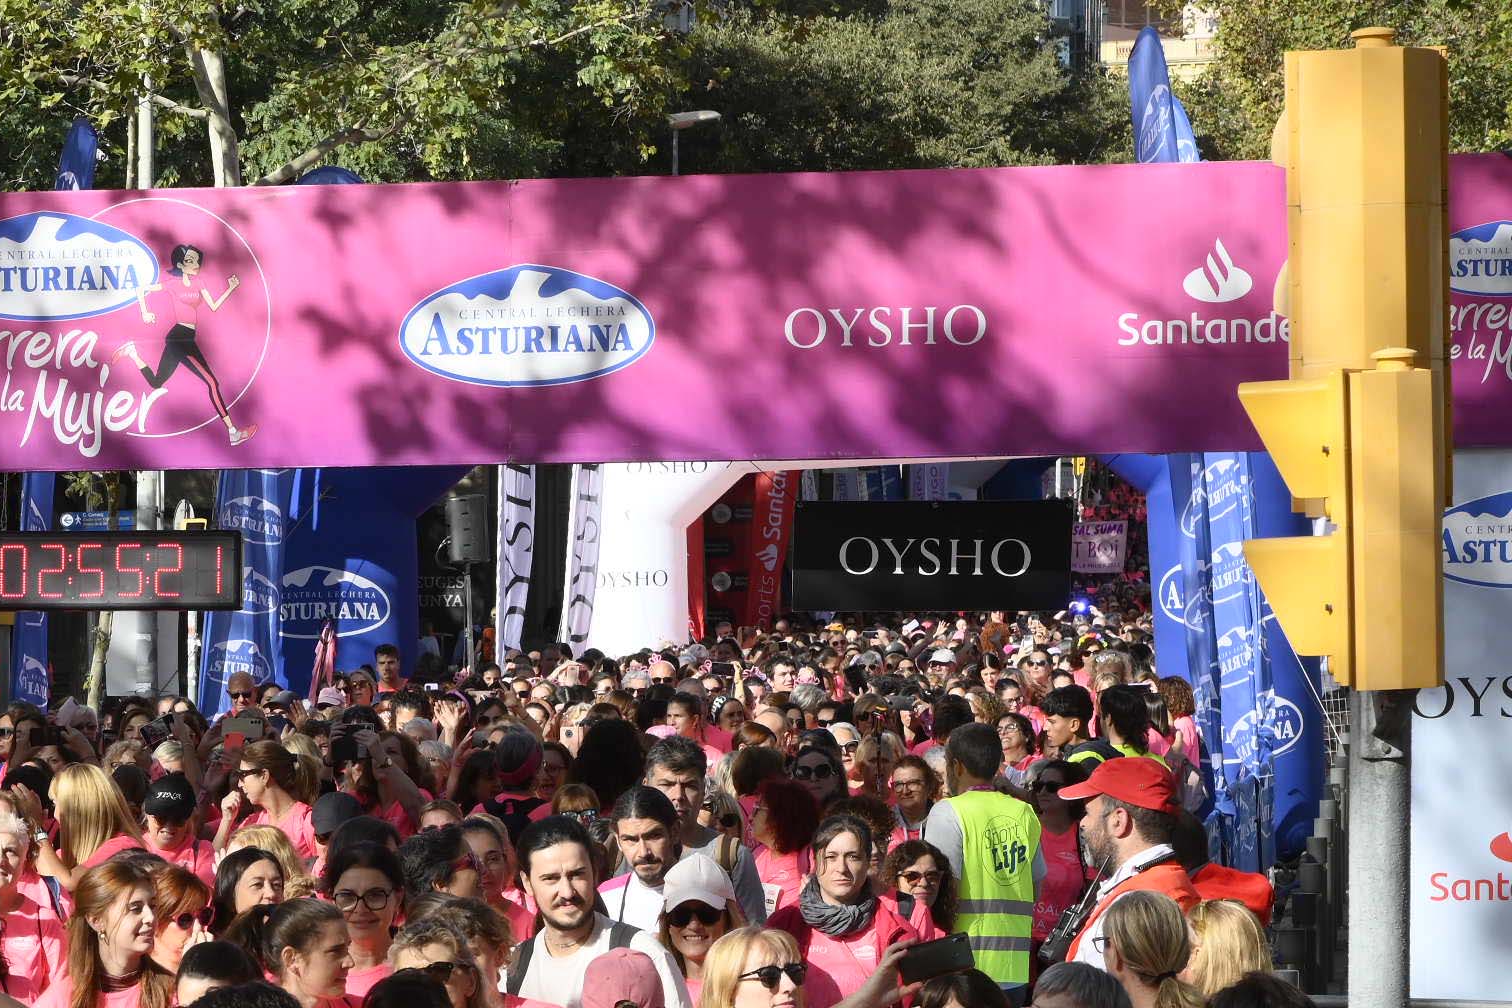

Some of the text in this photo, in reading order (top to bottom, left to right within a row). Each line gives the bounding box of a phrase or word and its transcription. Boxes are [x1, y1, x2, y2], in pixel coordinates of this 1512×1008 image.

[61, 247, 135, 259] LECHERA
[459, 304, 626, 320] CENTRAL LECHERA
[785, 304, 987, 348] OYSHO
[420, 312, 634, 356] ASTURIANA
[1468, 332, 1485, 360] la
[0, 370, 24, 412] la
[20, 363, 168, 458] Mujer
[1094, 523, 1124, 535] SUMA
[0, 543, 221, 598] 02:55:21
[839, 537, 1032, 577] OYSHO
[279, 601, 381, 622] STURIANA
[984, 822, 1022, 850] Sport
[992, 840, 1027, 875] Life
